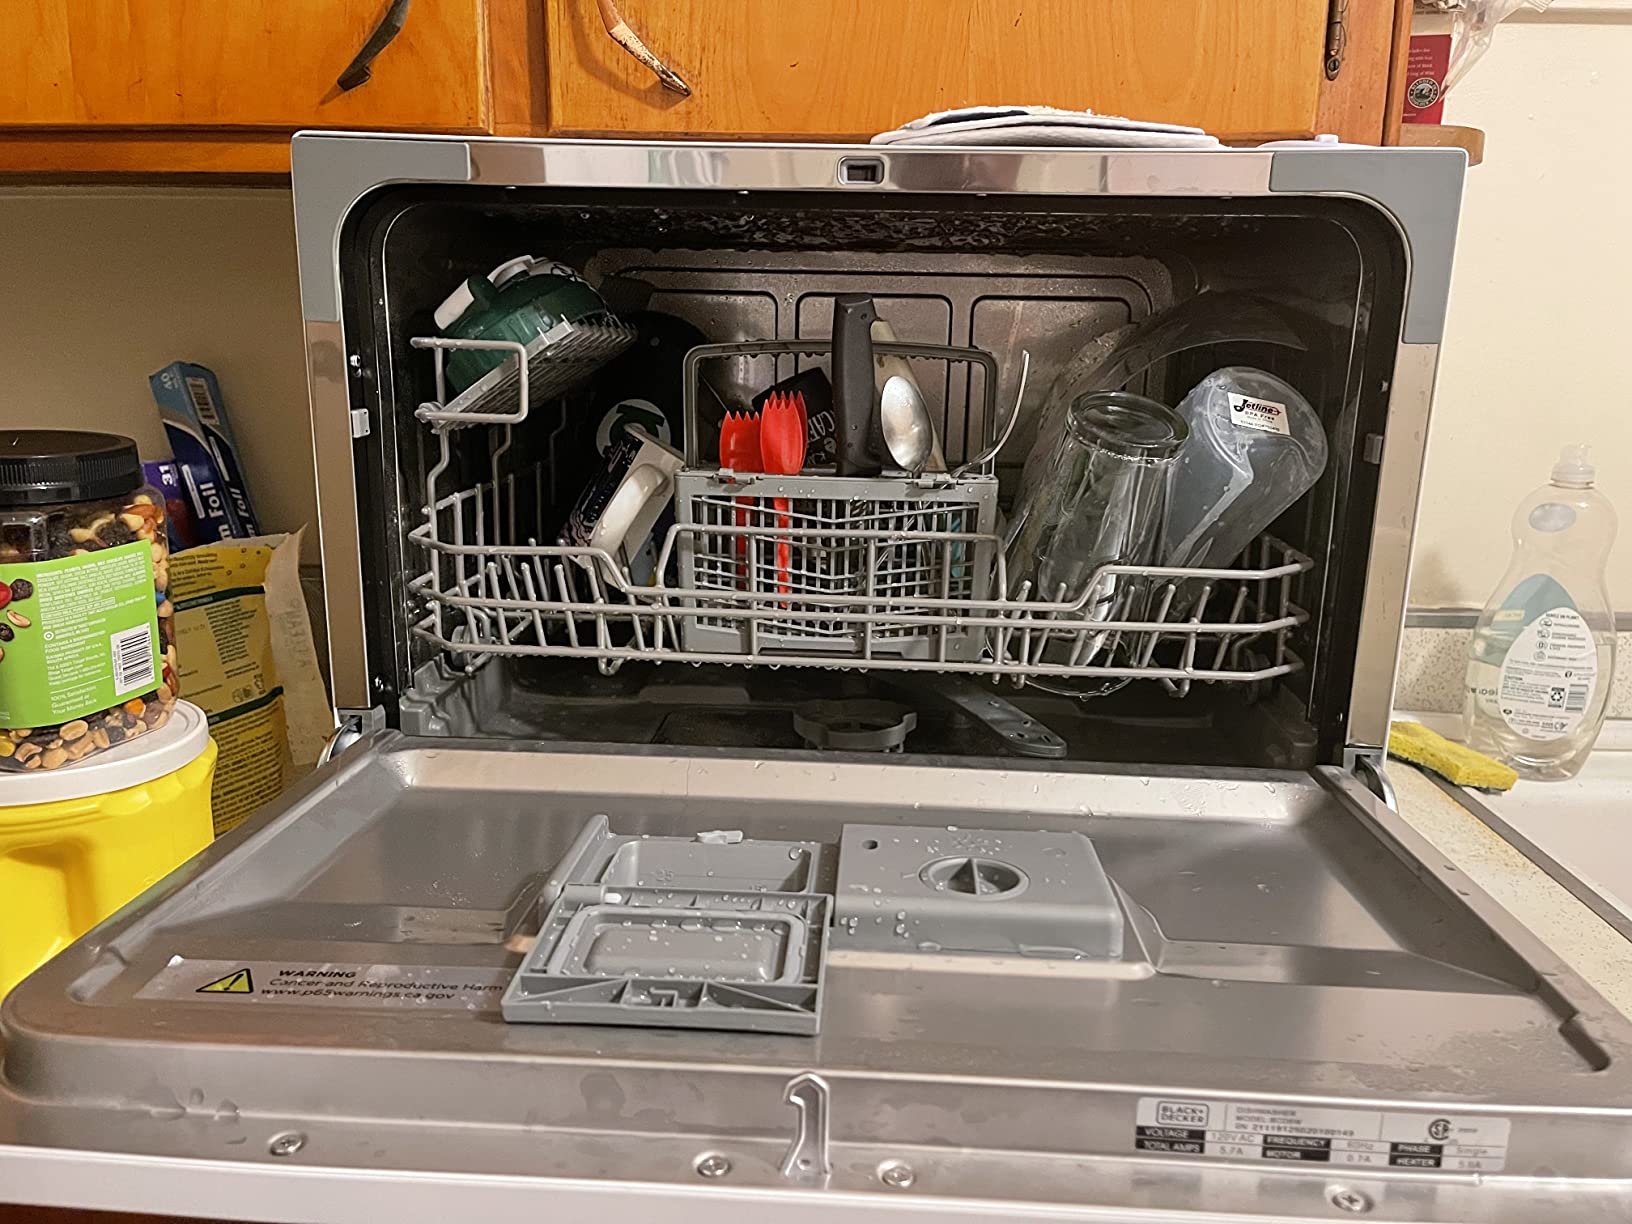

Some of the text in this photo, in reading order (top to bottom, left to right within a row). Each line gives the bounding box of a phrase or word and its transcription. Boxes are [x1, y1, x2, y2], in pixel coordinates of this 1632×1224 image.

[1233, 399, 1274, 415] Jetline
[158, 464, 173, 486] 31
[200, 481, 224, 519] Foil
[230, 487, 250, 518] Foil
[279, 969, 357, 978] WARNING
[269, 978, 504, 992] Cancer and Reproductive Harm
[261, 987, 455, 1000] www.p65warnings.ca.gov
[1161, 1105, 1204, 1115] BLACK+
[1161, 1113, 1204, 1124] DECKER
[1144, 1128, 1189, 1139] VOLTAGE
[1143, 1141, 1201, 1153] TOTAL AMPS
[1266, 1136, 1326, 1147] FREQUENCY
[1397, 1143, 1431, 1153] PHASE
[1266, 1149, 1301, 1159] MOTOR
[1396, 1156, 1436, 1167] HEATER
